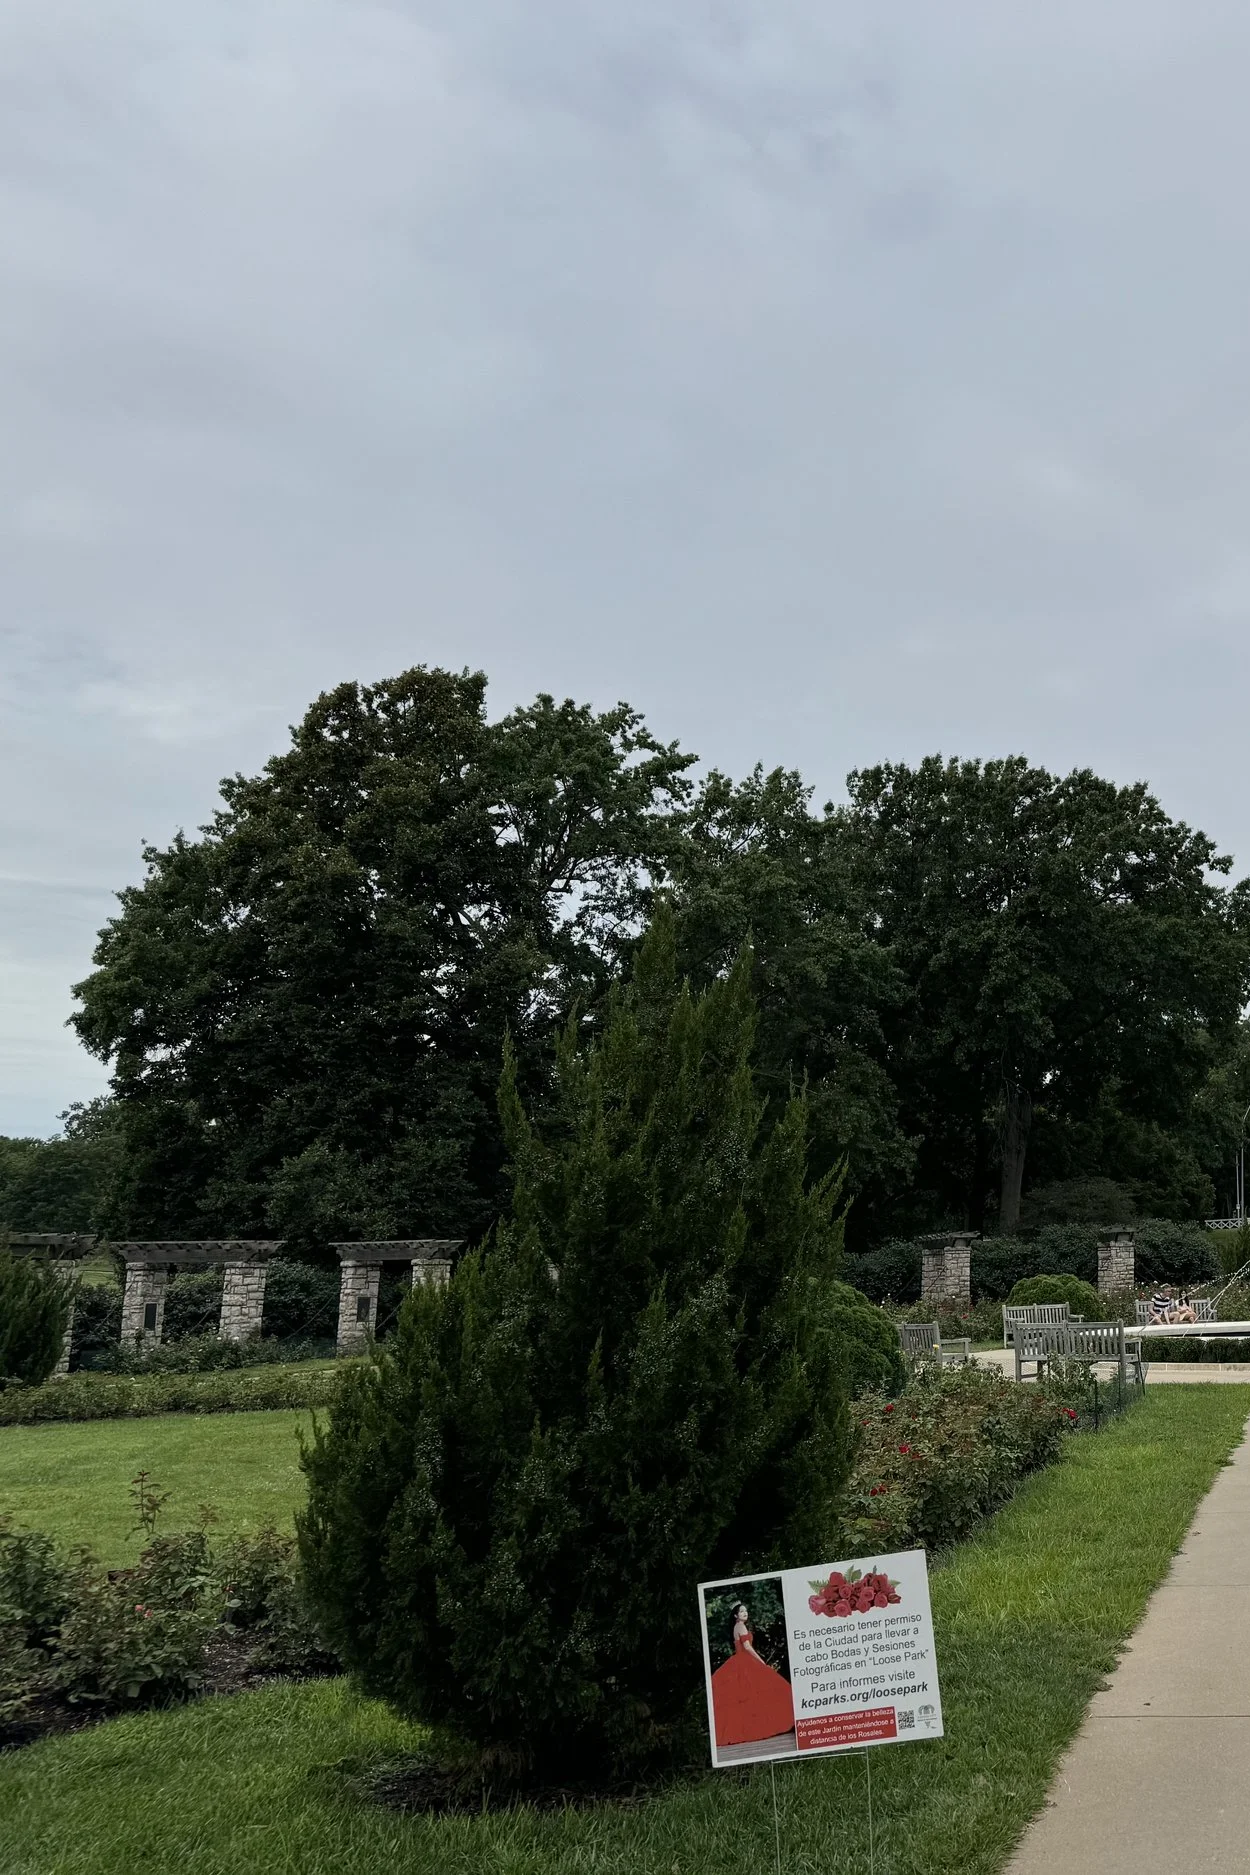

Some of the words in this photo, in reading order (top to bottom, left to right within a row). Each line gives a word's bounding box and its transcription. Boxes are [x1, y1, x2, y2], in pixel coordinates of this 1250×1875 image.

[794, 1630, 806, 1640] Es
[809, 1623, 855, 1637] necesario
[858, 1620, 881, 1630] tener
[884, 1614, 922, 1628] permiso
[799, 1642, 810, 1651] de
[814, 1640, 822, 1649] la
[825, 1634, 858, 1647] Ciudad
[862, 1632, 882, 1644] para
[885, 1628, 910, 1638] llevar
[805, 1652, 828, 1663] cabo
[831, 1647, 861, 1659] Bodas
[864, 1647, 869, 1656] y
[872, 1640, 915, 1653] Sesiones
[793, 1661, 852, 1677] Fotográficas
[855, 1660, 866, 1668] en
[811, 1680, 836, 1693] Para
[840, 1676, 885, 1689] informes
[889, 1669, 915, 1682] visite
[801, 1682, 928, 1709] kcparks.org/loosepark
[835, 1713, 864, 1722] conservar
[872, 1708, 894, 1717] belleza
[810, 1736, 837, 1744] distancia
